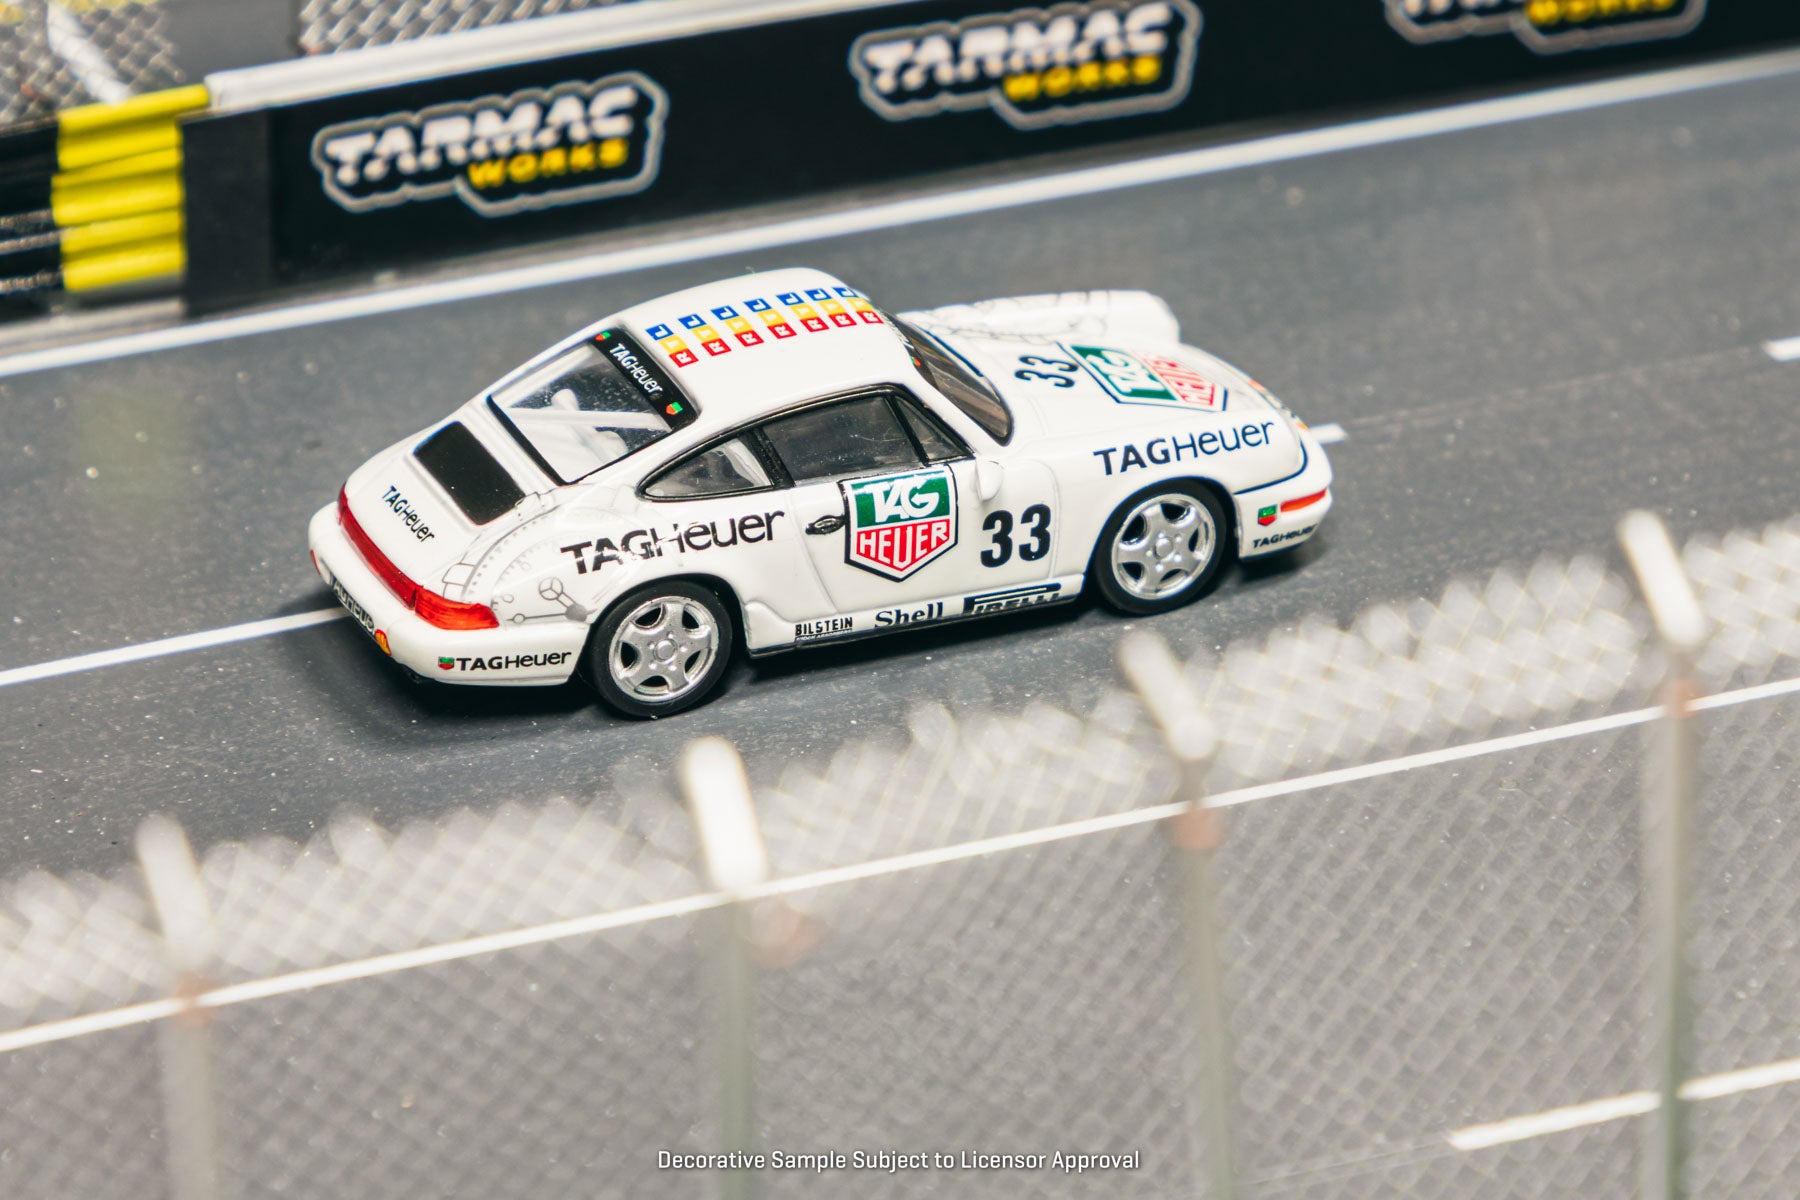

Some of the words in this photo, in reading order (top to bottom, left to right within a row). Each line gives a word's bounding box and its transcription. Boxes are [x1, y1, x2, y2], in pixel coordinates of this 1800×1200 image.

[865, 3, 1172, 94] TARMAC
[1004, 54, 1160, 101] WORKS
[326, 86, 637, 186] TARMAC
[468, 138, 628, 188] WORKS
[1014, 355, 1079, 388] 33
[856, 479, 940, 523] TAG
[859, 521, 949, 567] HEUER
[980, 503, 1051, 568] 33
[795, 616, 853, 637] BILSTEIN
[875, 602, 943, 628] Shell
